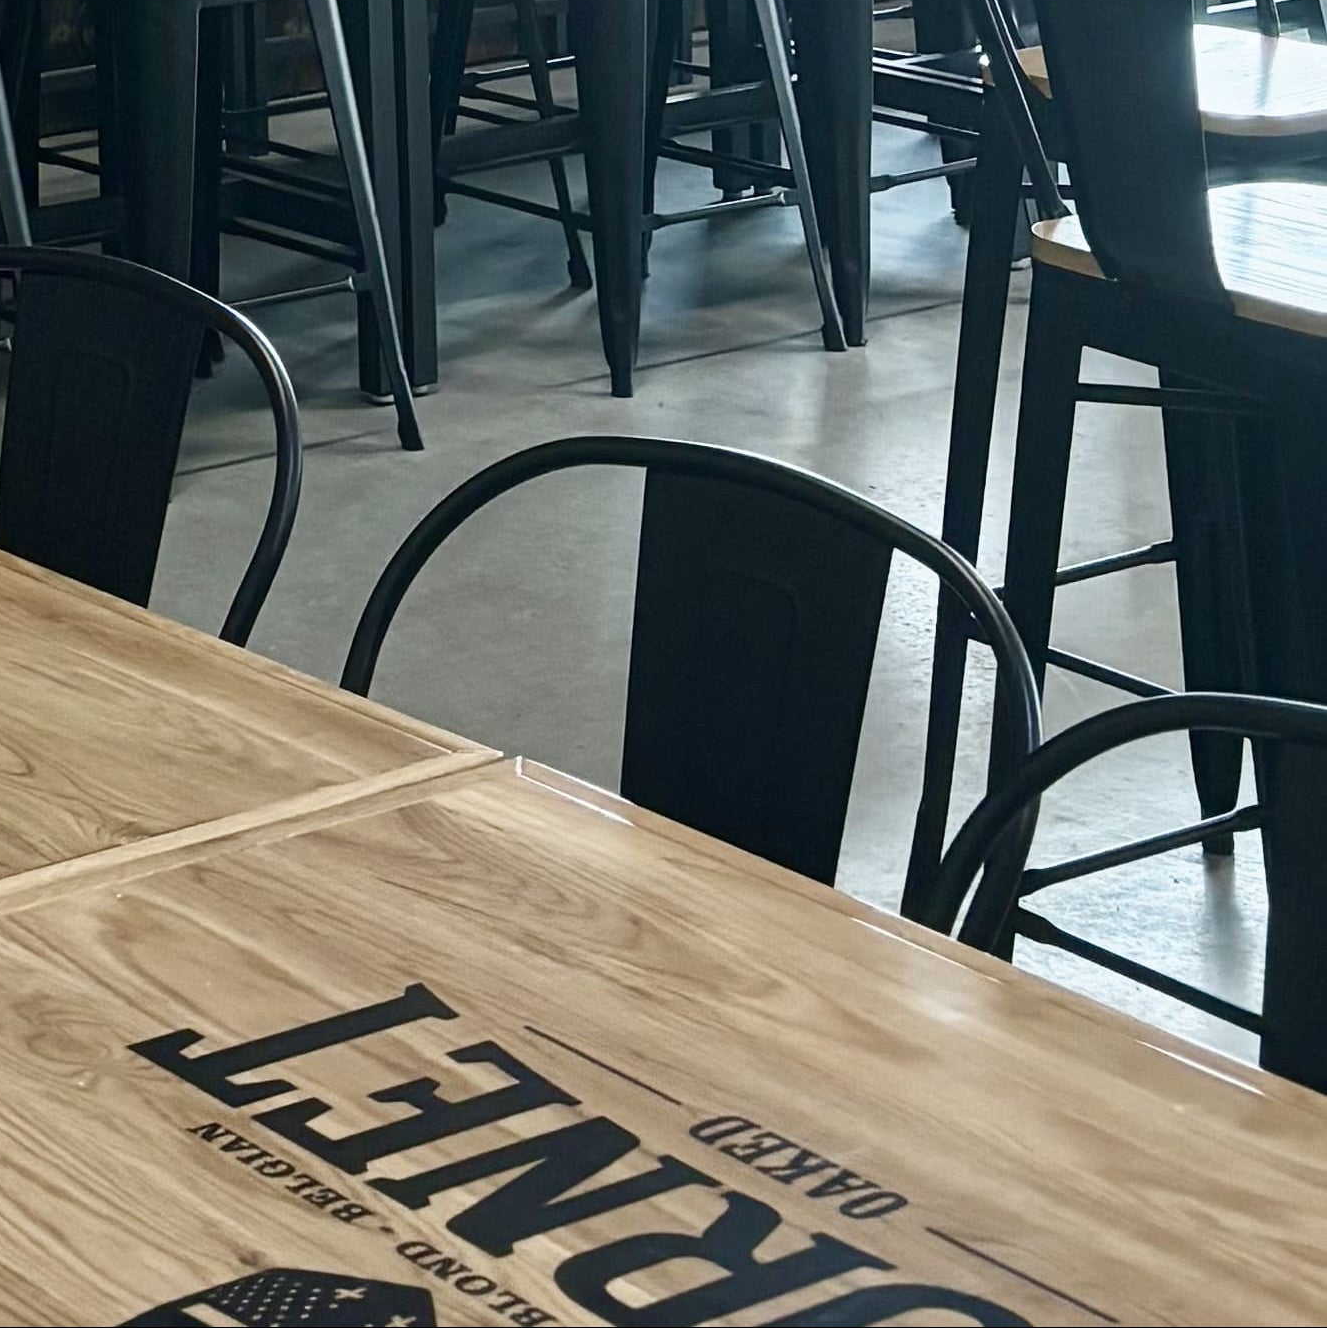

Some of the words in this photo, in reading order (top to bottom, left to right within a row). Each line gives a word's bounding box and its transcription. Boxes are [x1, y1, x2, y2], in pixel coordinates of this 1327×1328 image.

[187, 1118, 375, 1226] BELGIAN
[690, 1113, 911, 1221] OAKED
[396, 1238, 560, 1328] BLOND
